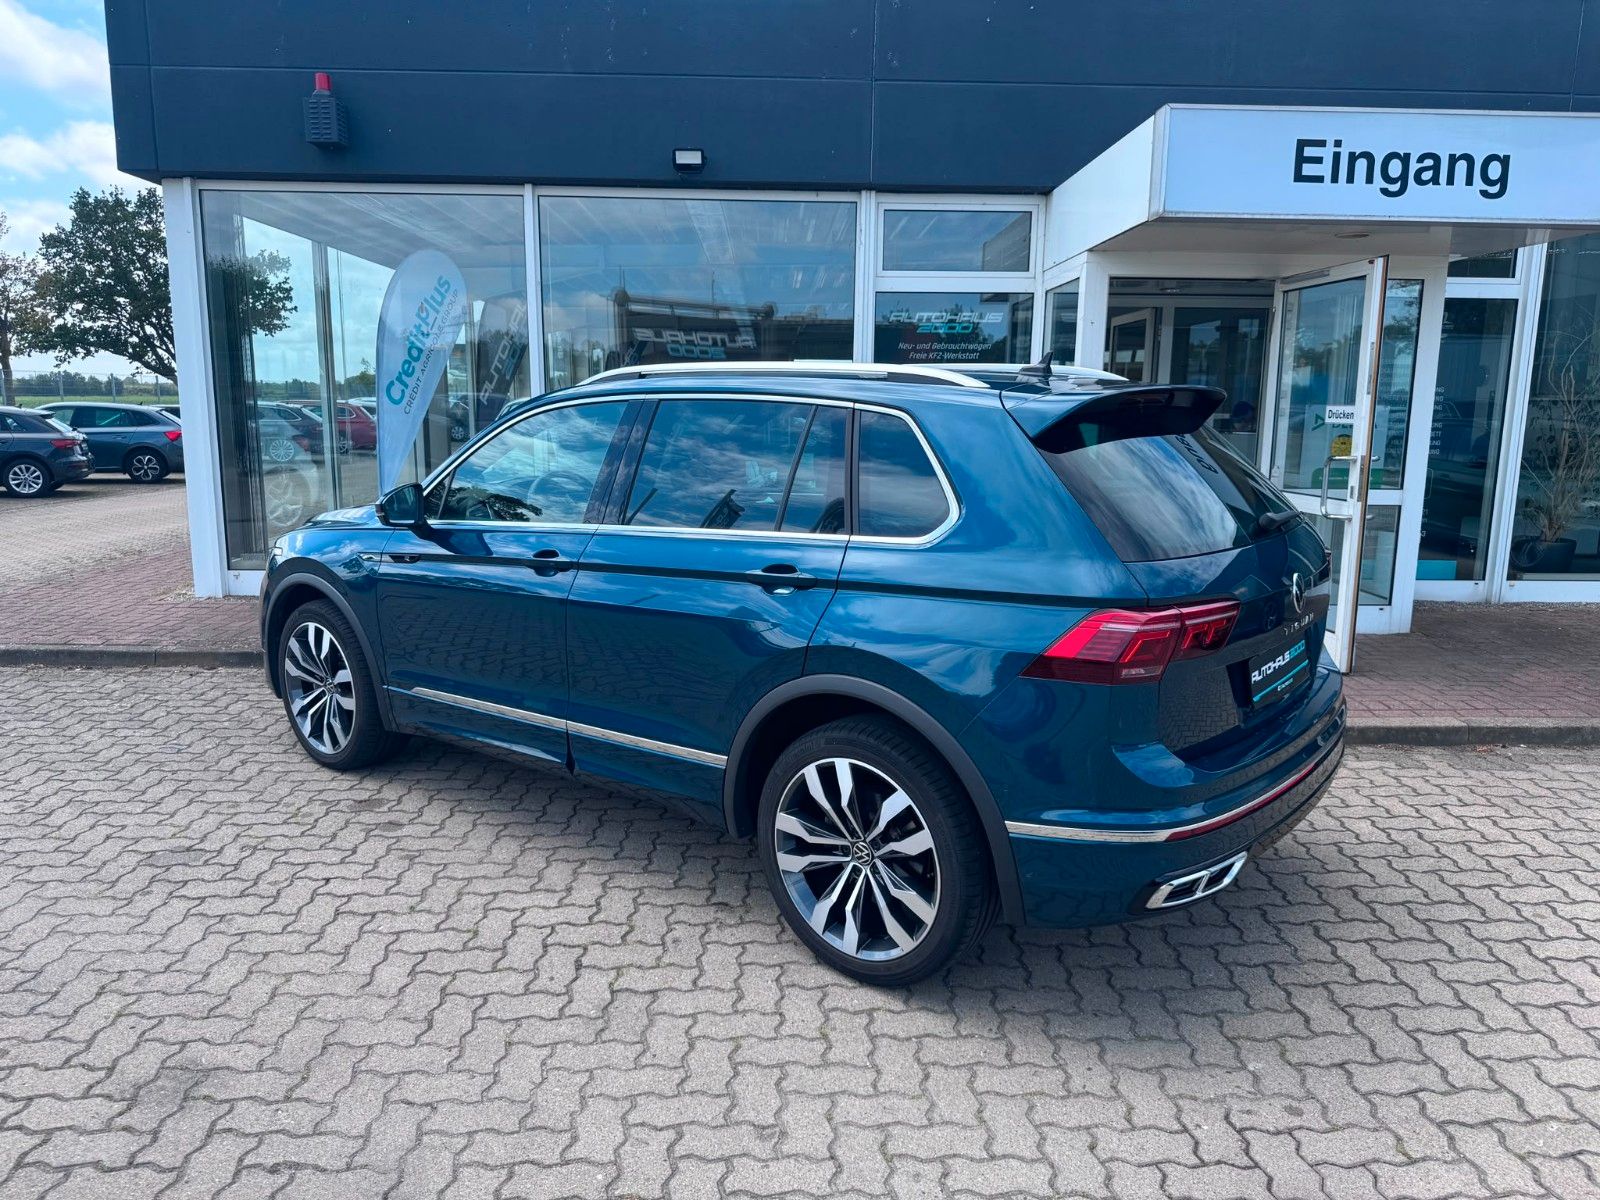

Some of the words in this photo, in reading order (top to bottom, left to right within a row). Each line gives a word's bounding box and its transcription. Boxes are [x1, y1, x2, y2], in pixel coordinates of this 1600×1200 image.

[1293, 138, 1511, 199] Eingang
[889, 312, 1003, 323] AUTOHAUS
[421, 325, 444, 376] AGRICOLE
[441, 288, 459, 325] GROUP
[917, 323, 973, 334] 2000
[898, 342, 916, 350] Neu-
[917, 342, 931, 350] und
[932, 342, 991, 351] Gebrauchtwagen
[909, 351, 927, 360] Freie
[1328, 409, 1354, 419] Drücken
